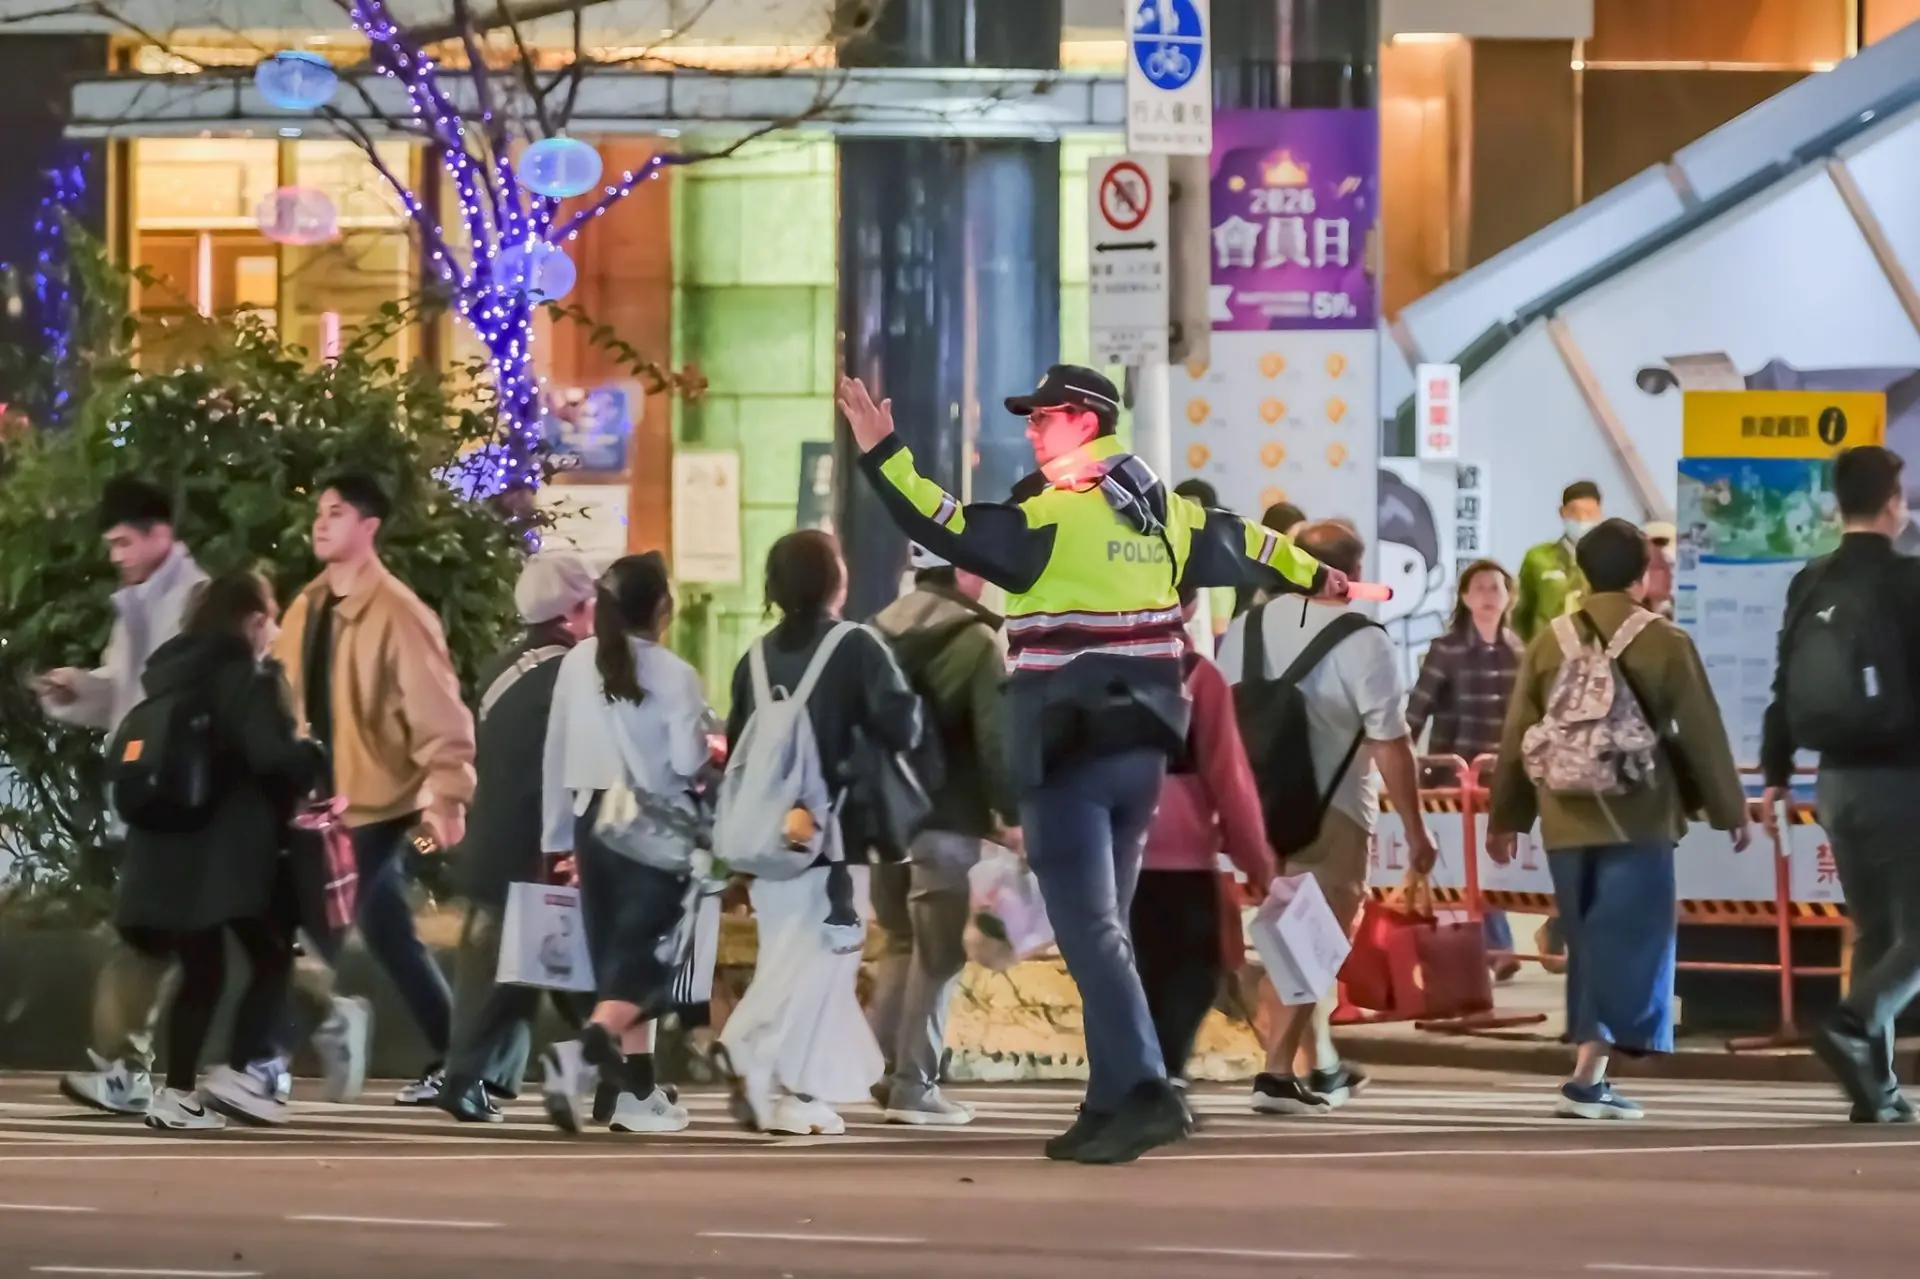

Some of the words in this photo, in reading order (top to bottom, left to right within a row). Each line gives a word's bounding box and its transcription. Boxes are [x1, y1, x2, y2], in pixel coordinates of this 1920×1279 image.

[1249, 188, 1316, 214] 2026
[1212, 215, 1350, 269] 會員日
